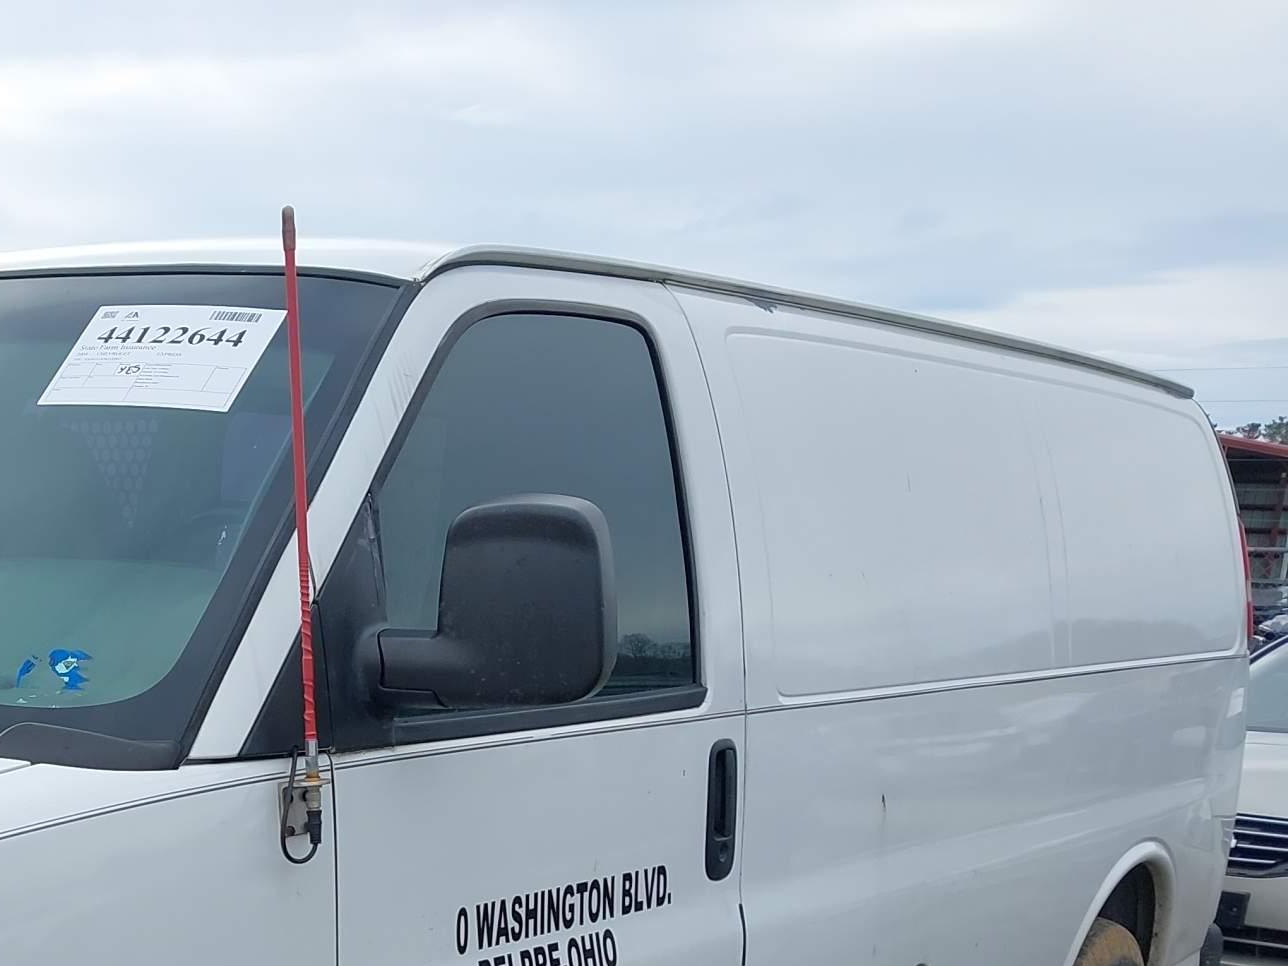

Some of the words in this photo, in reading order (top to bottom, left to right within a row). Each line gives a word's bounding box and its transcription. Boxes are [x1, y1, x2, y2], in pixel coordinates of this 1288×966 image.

[97, 326, 247, 347] 44122644
[475, 875, 615, 950] WASHINGTON
[621, 864, 672, 916] BLVD.
